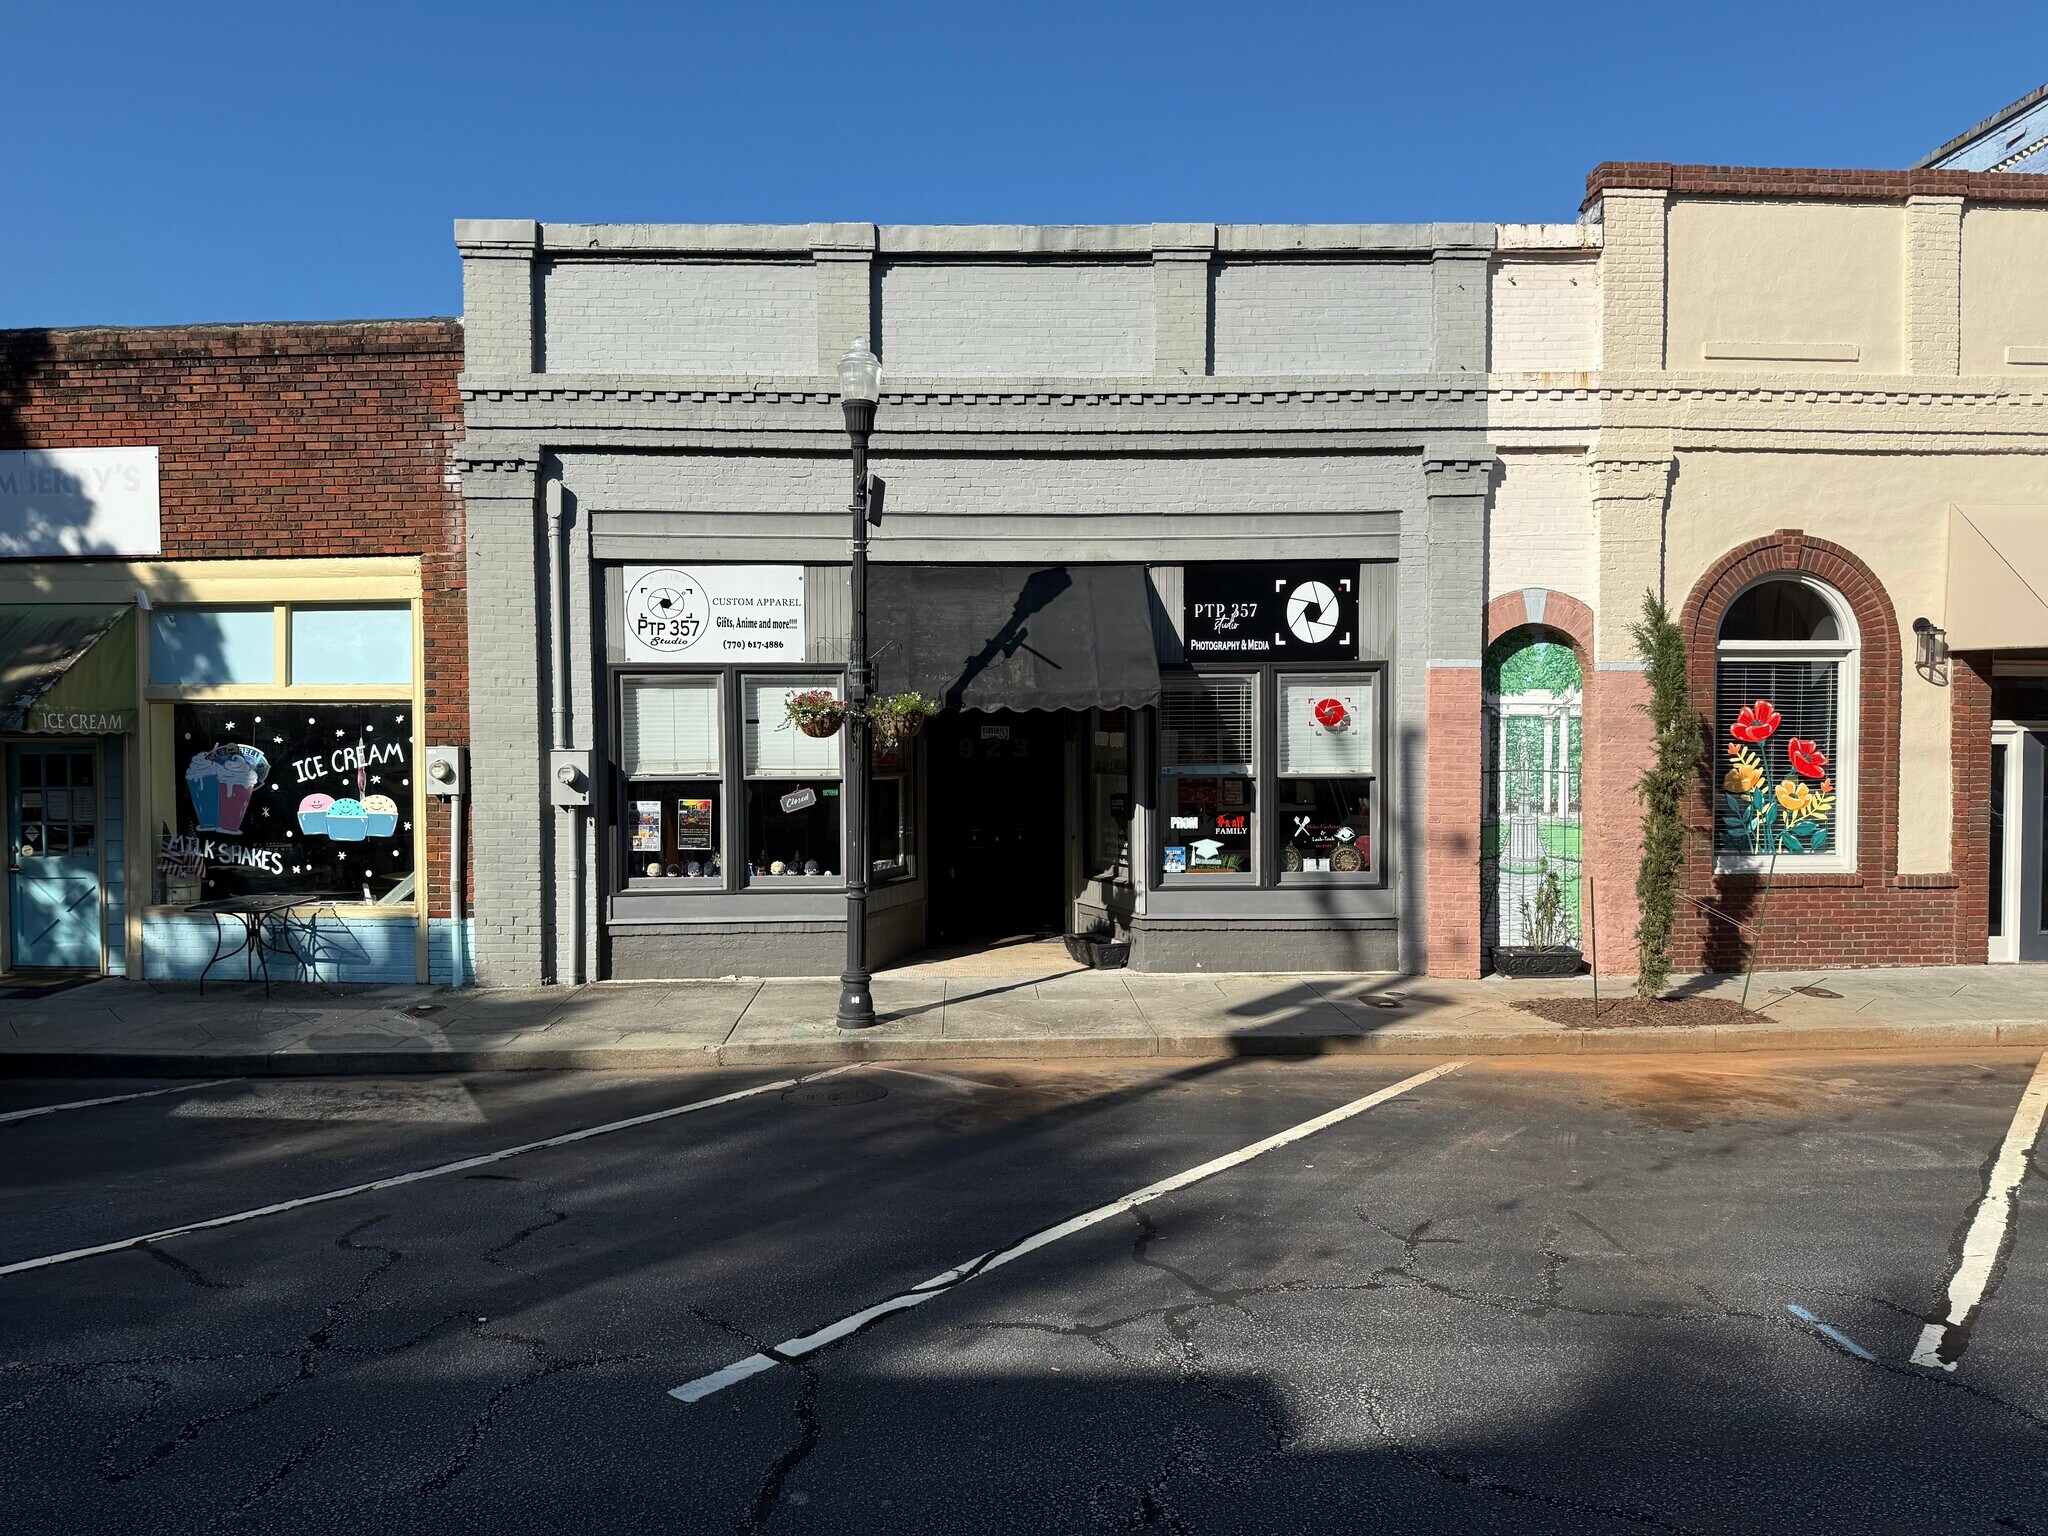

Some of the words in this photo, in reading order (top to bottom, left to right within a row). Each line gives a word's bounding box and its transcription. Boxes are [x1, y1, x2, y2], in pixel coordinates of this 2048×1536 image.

[712, 597, 754, 606] CUSTOM
[756, 598, 802, 607] APPAREL
[1194, 603, 1226, 618] PTP
[1231, 603, 1258, 618] 357
[637, 619, 666, 636] PTP
[670, 620, 700, 637] 357
[716, 616, 735, 631] Gifts,
[736, 617, 758, 629] Anime
[759, 618, 771, 629] and
[650, 637, 689, 647] Studio
[723, 640, 746, 650] (770)
[747, 641, 784, 650] 617-4886
[1190, 639, 1240, 651] PHOTOGRAPHY
[1240, 639, 1247, 651] &
[1247, 639, 1270, 651] MEDIA
[42, 712, 65, 729] ICE
[69, 713, 122, 730] CREAM
[292, 755, 328, 783] ICE
[331, 743, 404, 773] CREAM
[786, 792, 810, 808] Closed
[1170, 816, 1199, 829] PROM
[1214, 827, 1248, 835] FAMILY
[167, 834, 214, 860] MILK
[217, 843, 284, 876] SHAKES
